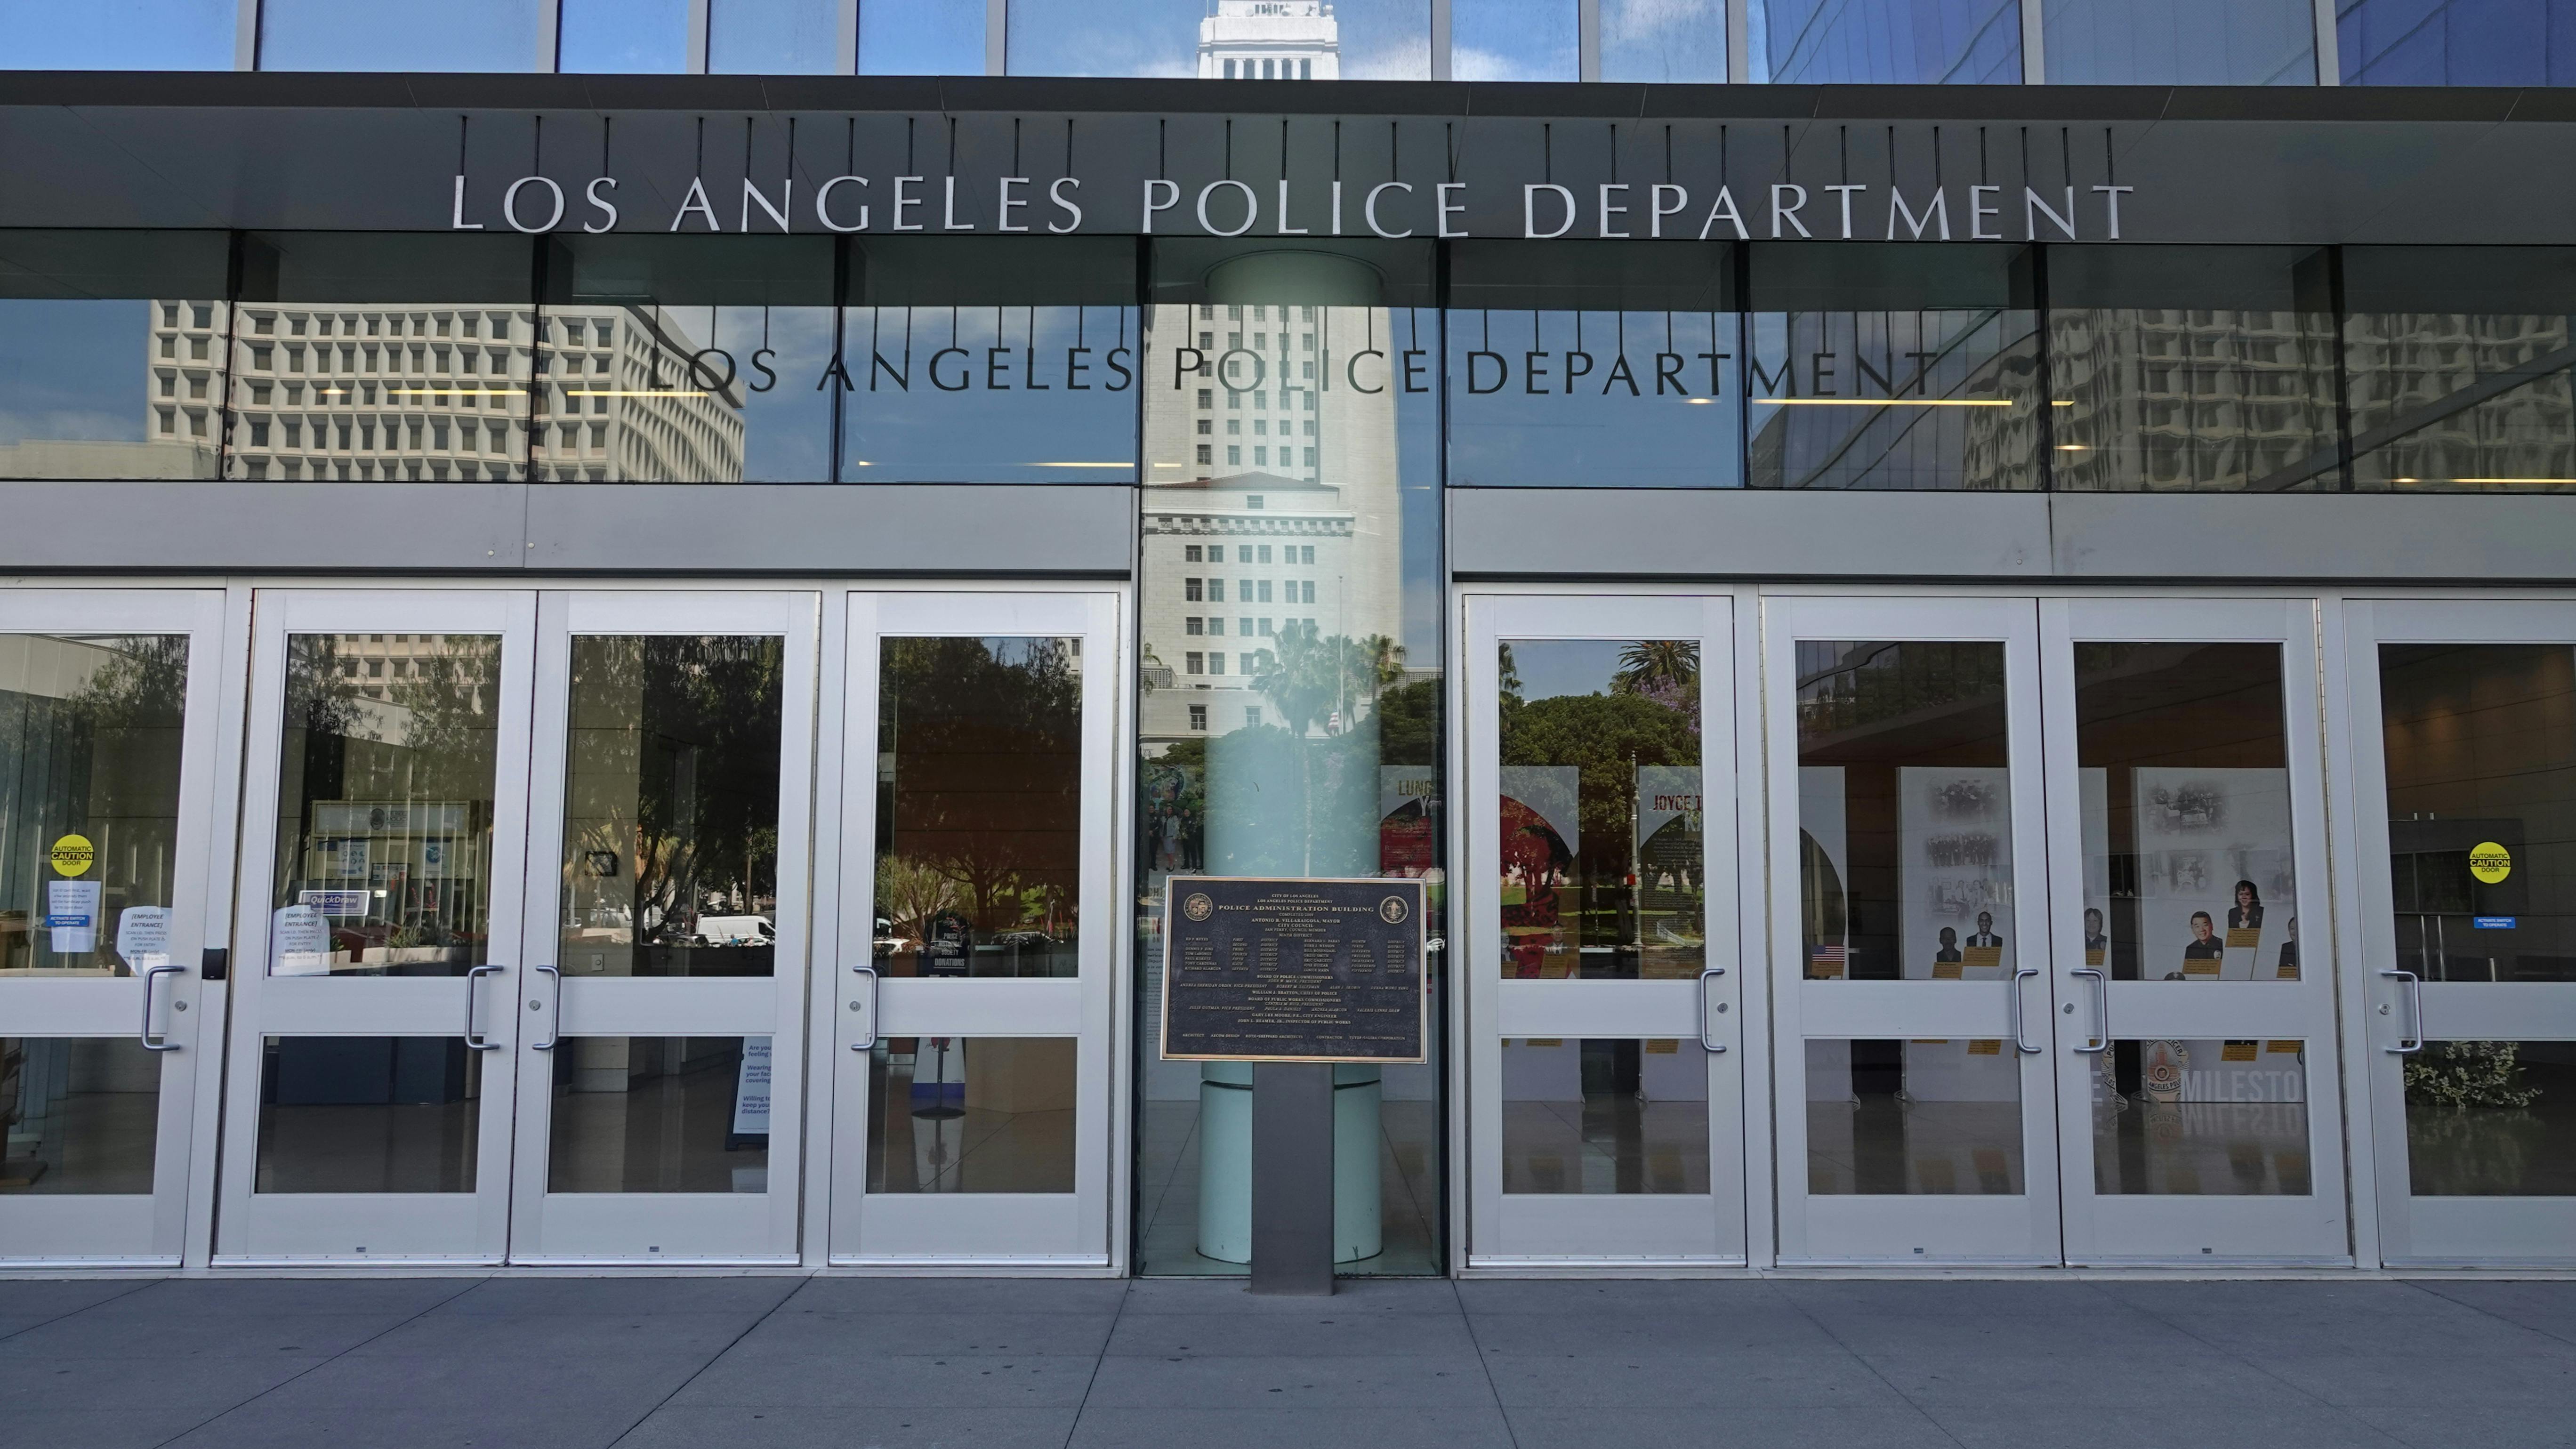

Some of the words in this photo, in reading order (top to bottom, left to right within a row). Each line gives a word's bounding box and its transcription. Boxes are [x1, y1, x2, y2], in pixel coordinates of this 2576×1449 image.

[453, 175, 619, 233] LOS
[671, 176, 1083, 234] ANGELES
[1143, 180, 1469, 238] POLICE
[1523, 184, 2133, 242] DEPARTMENT
[651, 348, 778, 393] LOS
[818, 348, 1133, 393] ANGELES
[1175, 347, 1428, 395] POLICE
[1467, 351, 1940, 398] DEPARTMENT
[1653, 795, 1691, 811] JOYCE
[311, 896, 358, 905] QuickDraw
[934, 958, 965, 966] DONATIONS
[2148, 1080, 2169, 1089] ANGELES
[2180, 1070, 2300, 1102] MILESTO
